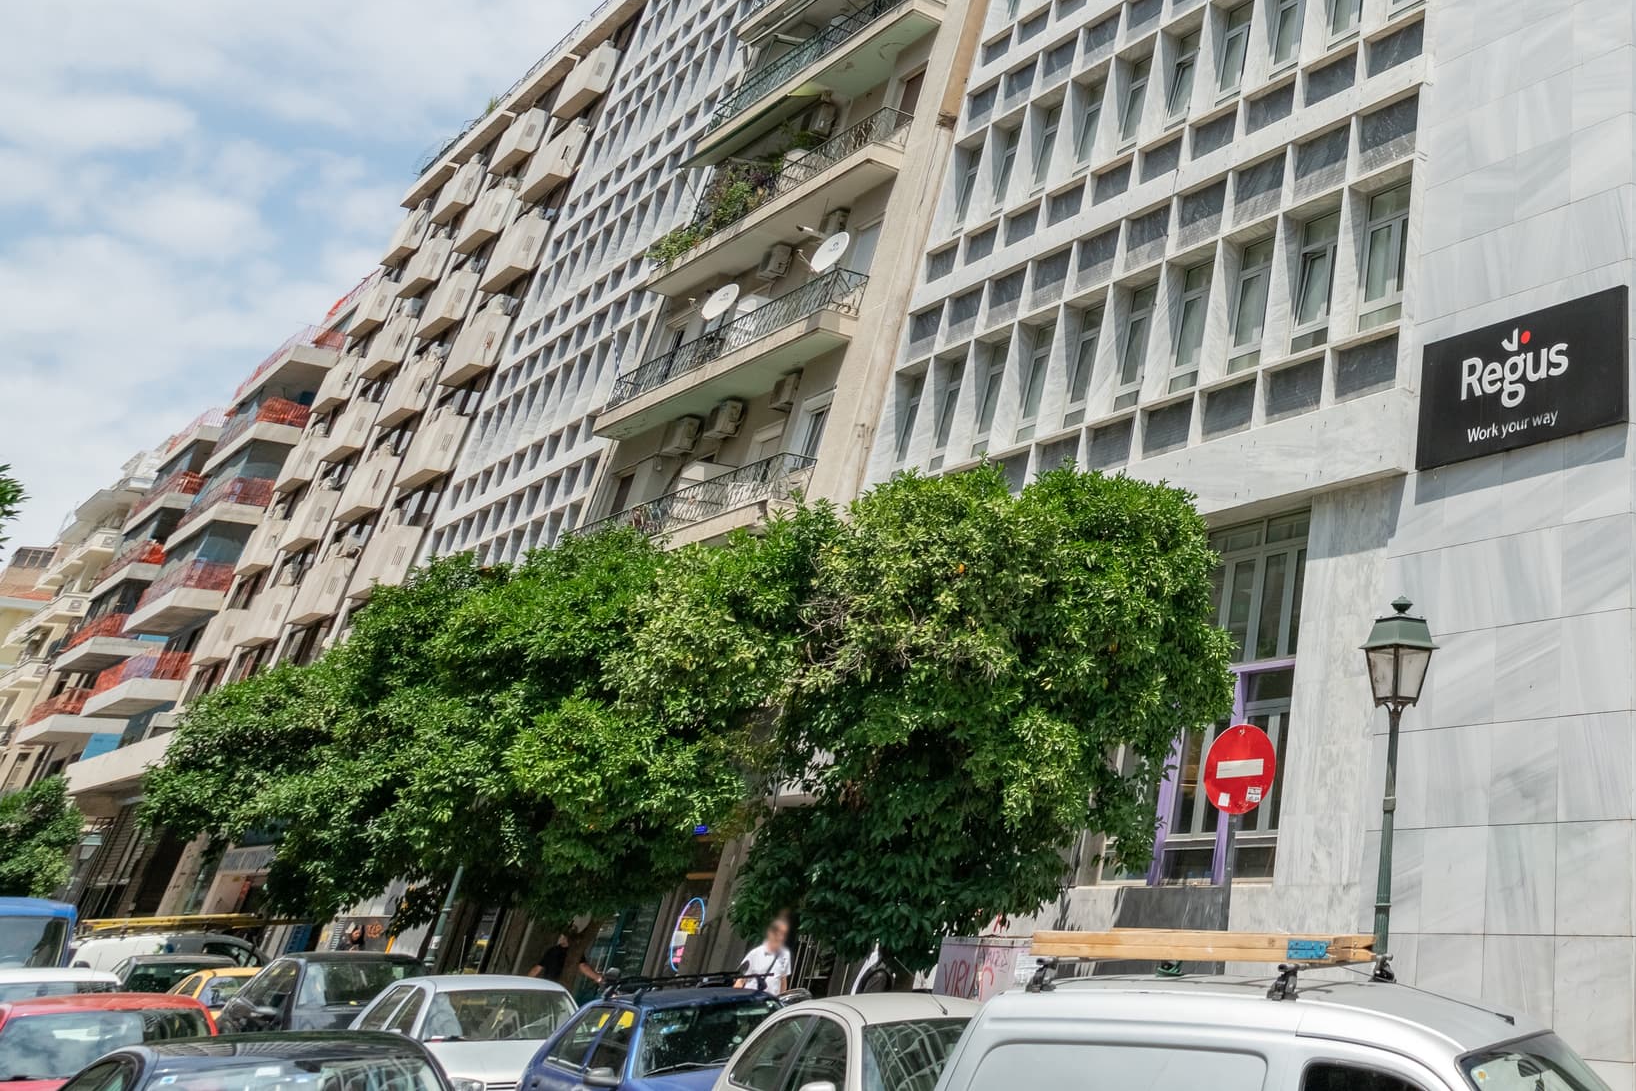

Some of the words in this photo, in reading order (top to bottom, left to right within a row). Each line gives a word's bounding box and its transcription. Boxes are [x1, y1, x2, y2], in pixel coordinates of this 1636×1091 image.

[1460, 342, 1569, 408] Regus
[1467, 422, 1499, 444] Work
[1501, 417, 1530, 439] your
[1532, 410, 1559, 427] way
